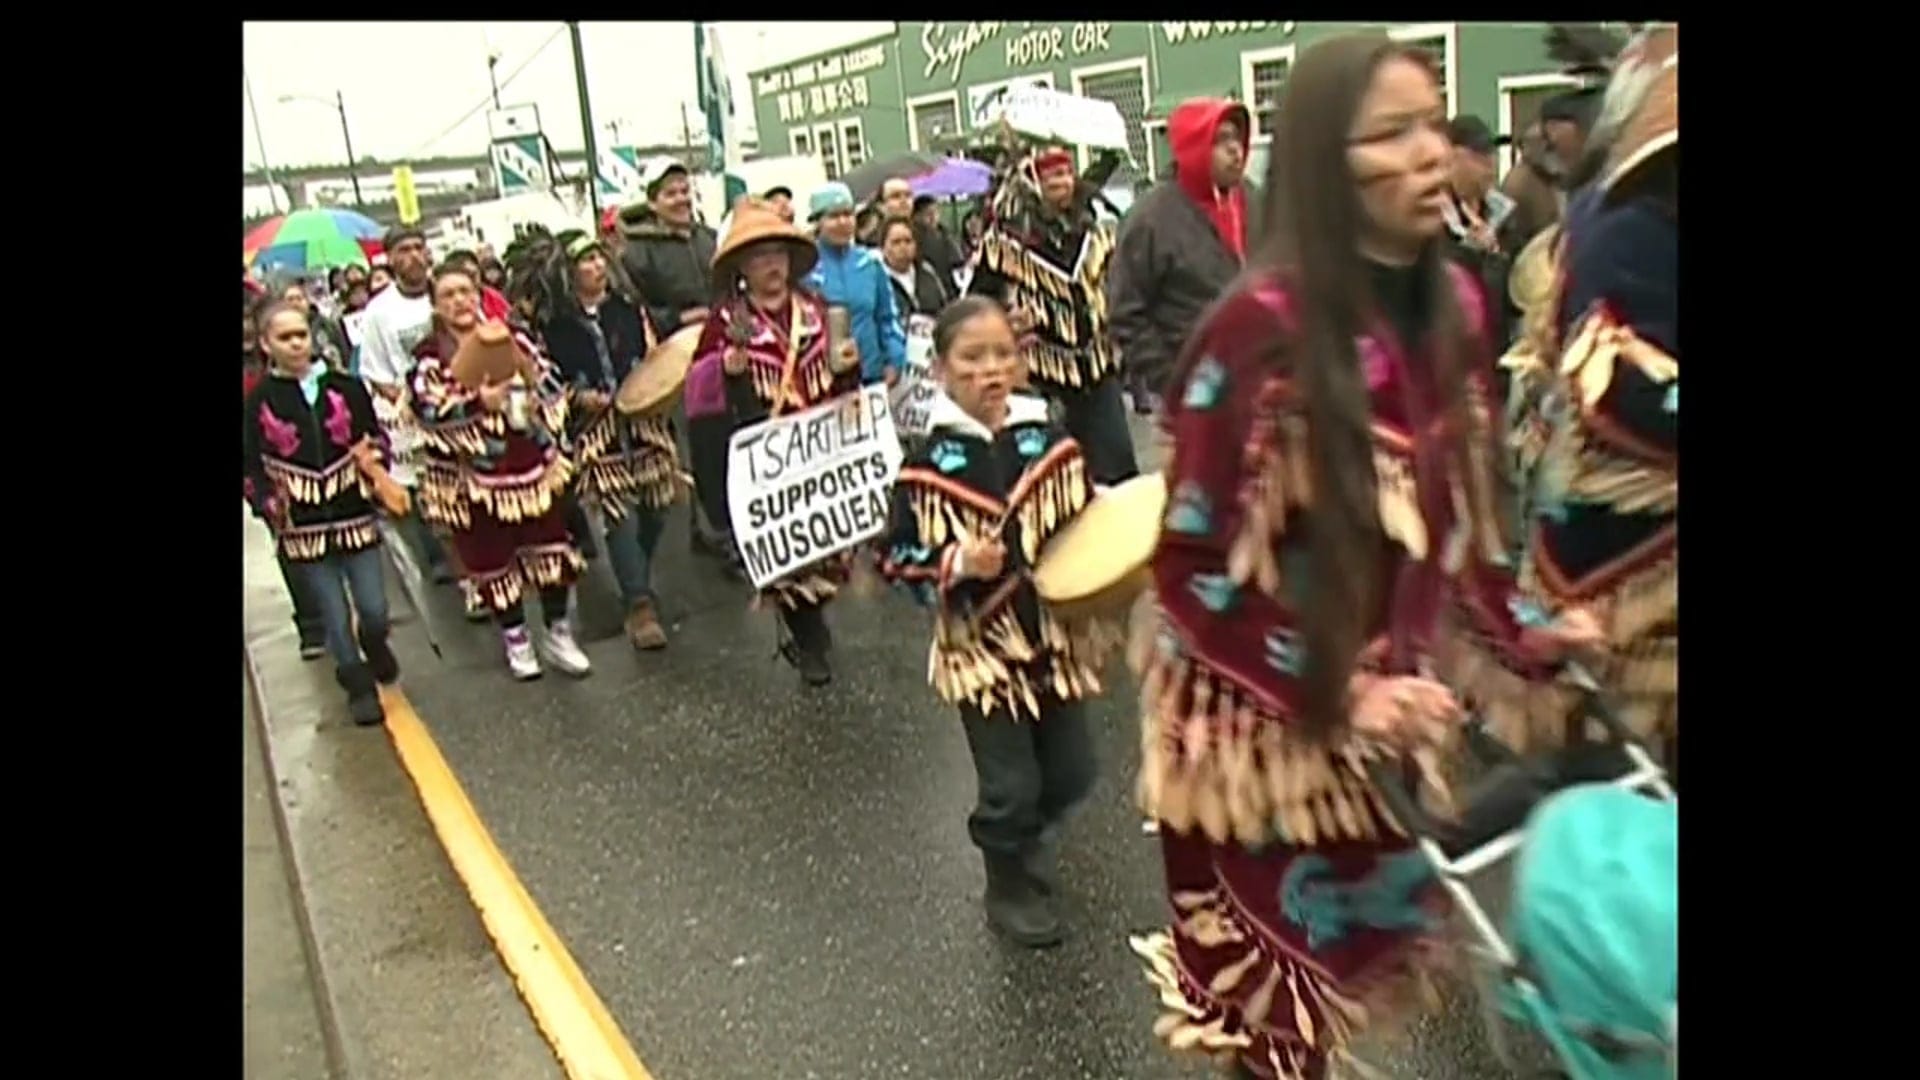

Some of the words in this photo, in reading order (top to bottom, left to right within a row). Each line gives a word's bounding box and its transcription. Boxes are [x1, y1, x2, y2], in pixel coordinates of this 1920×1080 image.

[1005, 27, 1064, 67] MOTOR
[1071, 22, 1111, 54] CAR
[736, 392, 887, 483] TSARTLIP
[748, 451, 889, 529] SUPPORTS
